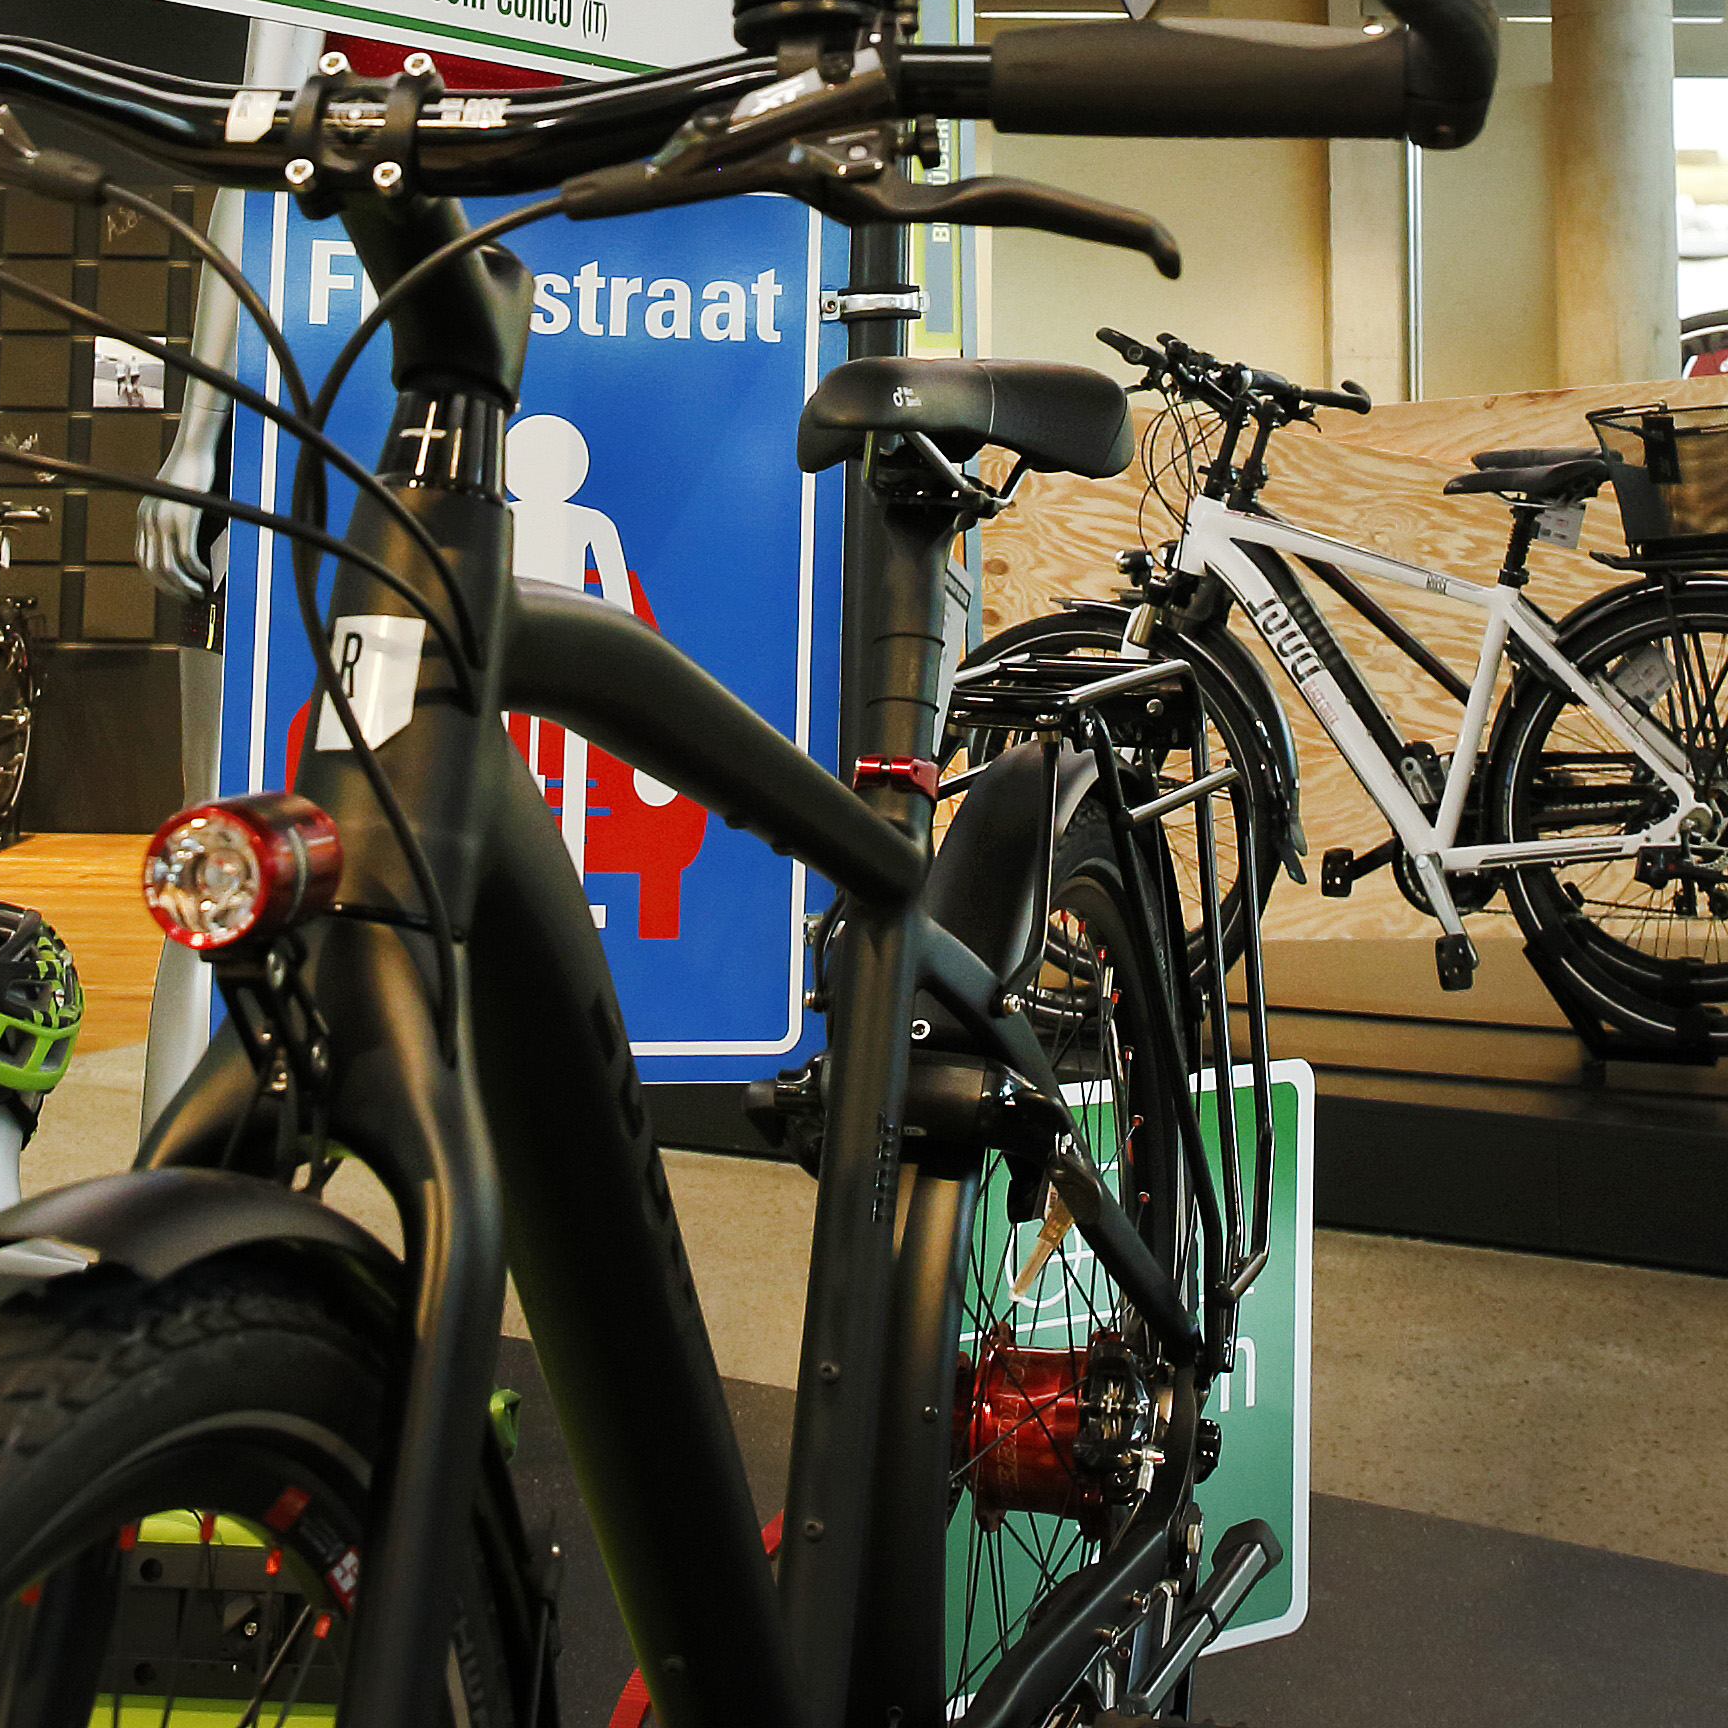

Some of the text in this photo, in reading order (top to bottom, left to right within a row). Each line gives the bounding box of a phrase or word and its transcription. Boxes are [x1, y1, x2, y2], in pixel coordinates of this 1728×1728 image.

[583, 0, 607, 42] (IT)
[308, 238, 783, 344] Fstraat
[341, 632, 363, 698] R
